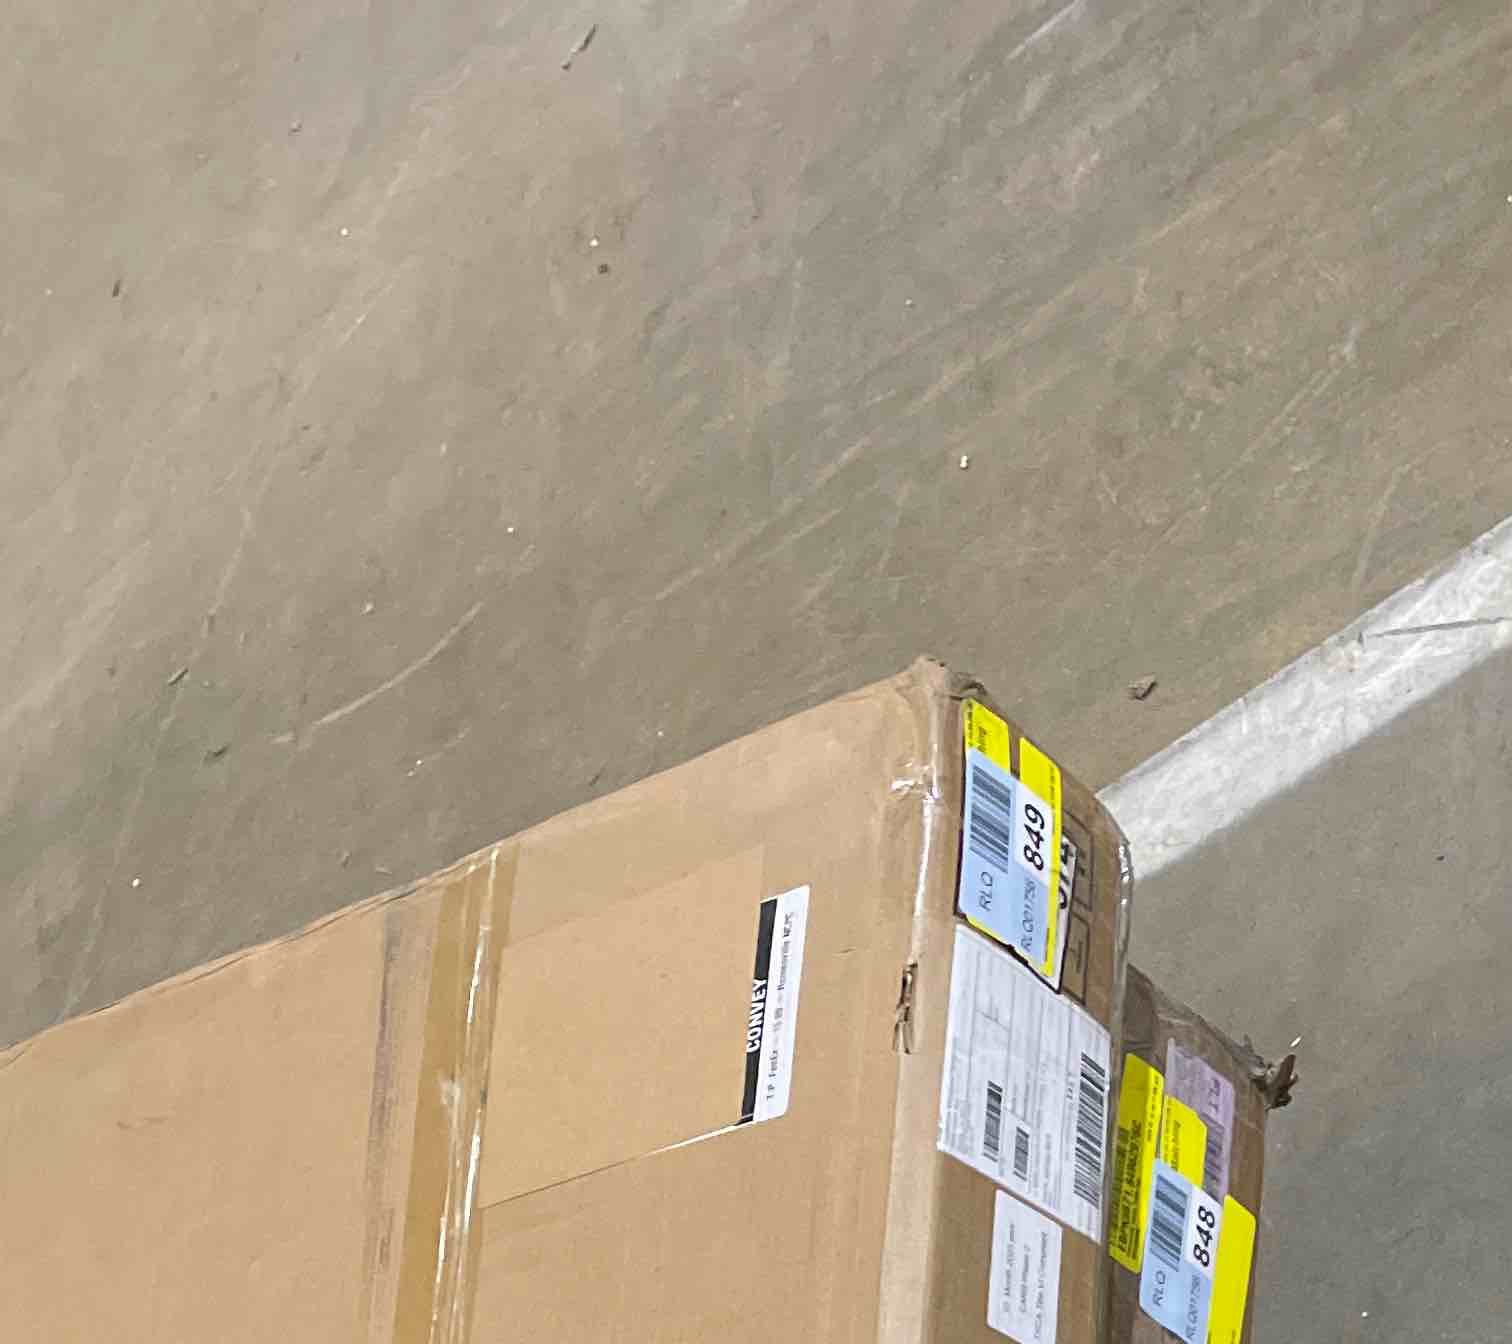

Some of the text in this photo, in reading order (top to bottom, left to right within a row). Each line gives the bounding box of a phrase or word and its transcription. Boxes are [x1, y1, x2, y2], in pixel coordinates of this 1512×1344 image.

[1023, 803, 1045, 872] 849
[746, 977, 768, 1054] CONVEY
[1193, 1204, 1216, 1268] 848
